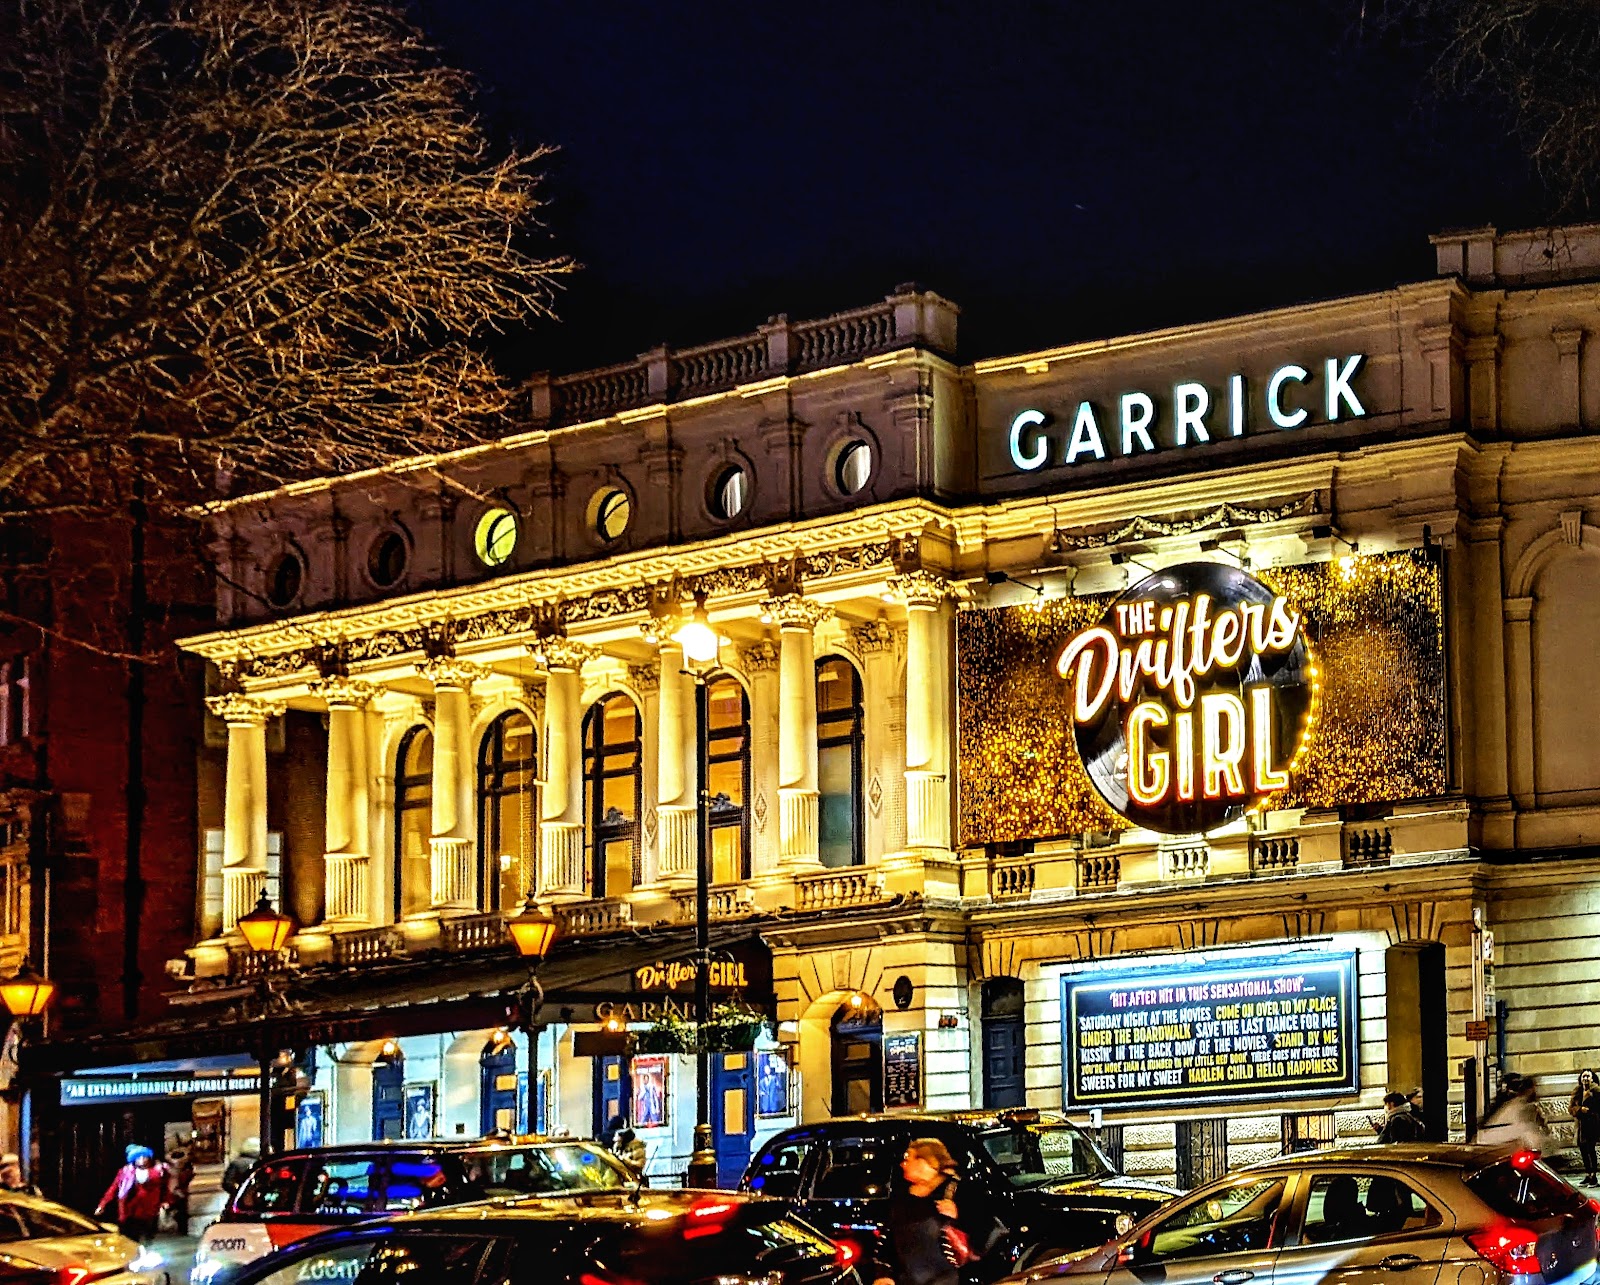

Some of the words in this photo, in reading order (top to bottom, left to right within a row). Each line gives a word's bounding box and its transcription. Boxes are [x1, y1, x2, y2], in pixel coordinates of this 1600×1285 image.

[1009, 354, 1366, 471] GARRICK
[1116, 601, 1155, 636] THE
[1057, 595, 1299, 722] Drifters
[1128, 688, 1291, 806] GIRL
[636, 962, 698, 990] Drifter
[709, 961, 748, 987] GIRL
[1130, 990, 1156, 1006] AFTER
[1159, 988, 1174, 1003] HIT
[1176, 987, 1186, 1002] IN
[1188, 985, 1209, 1000] THIS
[1211, 980, 1272, 999] SENSATIONAL
[1080, 1014, 1121, 1030] SATURDAY
[1123, 1012, 1148, 1027] NIGHT
[1150, 1010, 1160, 1026] AT
[1162, 1009, 1178, 1024] THE
[1180, 1006, 1211, 1023] MOVIES
[1215, 1004, 1240, 1020] COME
[1242, 1003, 1254, 1018] ON
[1256, 1001, 1279, 1016] OVER
[1280, 1000, 1292, 1015] TO
[1294, 998, 1308, 1013] MY
[1309, 997, 1337, 1012] PLACE
[1081, 1030, 1112, 1047] UNDER
[1114, 1028, 1131, 1045] THE
[1133, 1023, 1191, 1043] BOARDWALK
[1196, 1021, 1221, 1038] SAVE
[1221, 1019, 1239, 1036] THE
[1242, 1016, 1265, 1034] LAST
[1266, 1014, 1299, 1033] DANCE
[1300, 1013, 1319, 1030] FOR
[1322, 1012, 1338, 1029] ME
[1104, 1062, 1121, 1073] MORE
[1123, 1060, 1139, 1072] THAN
[1141, 1060, 1146, 1071] A
[1183, 1056, 1193, 1067] MY
[1195, 1055, 1214, 1067] LITTLE
[1251, 1051, 1271, 1063] THERE
[1272, 1050, 1289, 1061] GOES
[1290, 1049, 1300, 1060] MY
[1302, 1048, 1320, 1059] FIRST
[1322, 1046, 1338, 1057] LOVE
[1115, 1045, 1125, 1060] IN
[1129, 1043, 1145, 1060] THE
[1148, 1041, 1172, 1058] BACK
[1174, 1039, 1196, 1056] ROW
[1200, 1038, 1211, 1054] OF
[1214, 1036, 1230, 1053] THE
[1234, 1035, 1268, 1052] MOVIES
[1275, 1032, 1303, 1048] STAND
[1307, 1031, 1320, 1045] BY
[1323, 1030, 1338, 1044] ME
[87, 1080, 174, 1097] EXTRAORDINARILY
[176, 1079, 227, 1093] ENJOYABLE
[228, 1078, 255, 1090] NIGHT
[1081, 1074, 1115, 1091] SWEETS
[1118, 1073, 1135, 1089] FOR
[1137, 1071, 1152, 1087] MY
[1153, 1069, 1183, 1086] SWEET
[1188, 1067, 1224, 1084] HARLEM
[1227, 1064, 1253, 1081] CHILD
[1256, 1061, 1284, 1079] HELLO
[1287, 1058, 1338, 1077] HAPPINESS
[211, 1238, 246, 1251] zoom
